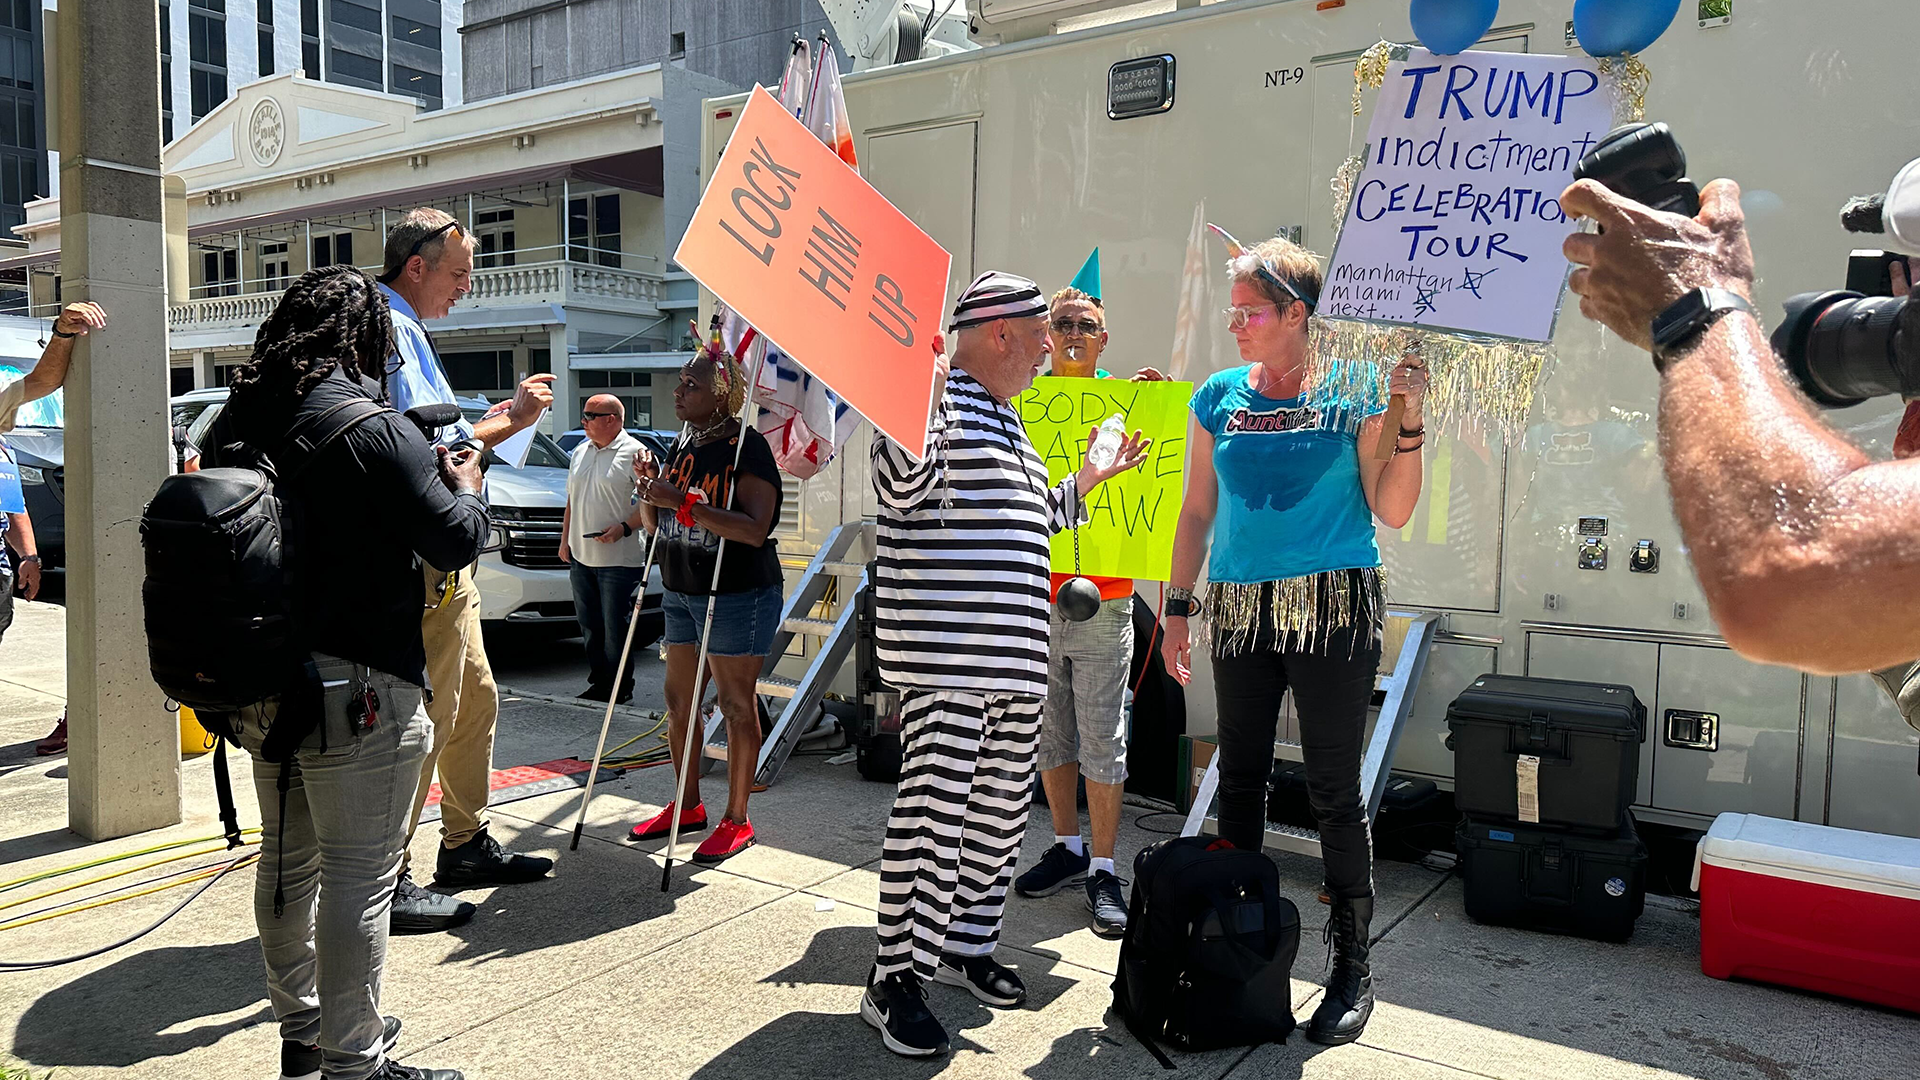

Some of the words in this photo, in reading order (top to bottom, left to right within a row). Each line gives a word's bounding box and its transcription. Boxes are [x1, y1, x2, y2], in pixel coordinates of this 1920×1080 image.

[1402, 65, 1599, 125] TRUMP
[718, 136, 802, 267] LOCK
[798, 206, 862, 312] HIM
[1400, 225, 1529, 262] TOUR
[868, 273, 918, 348] UP
[1020, 388, 1139, 426] BODY
